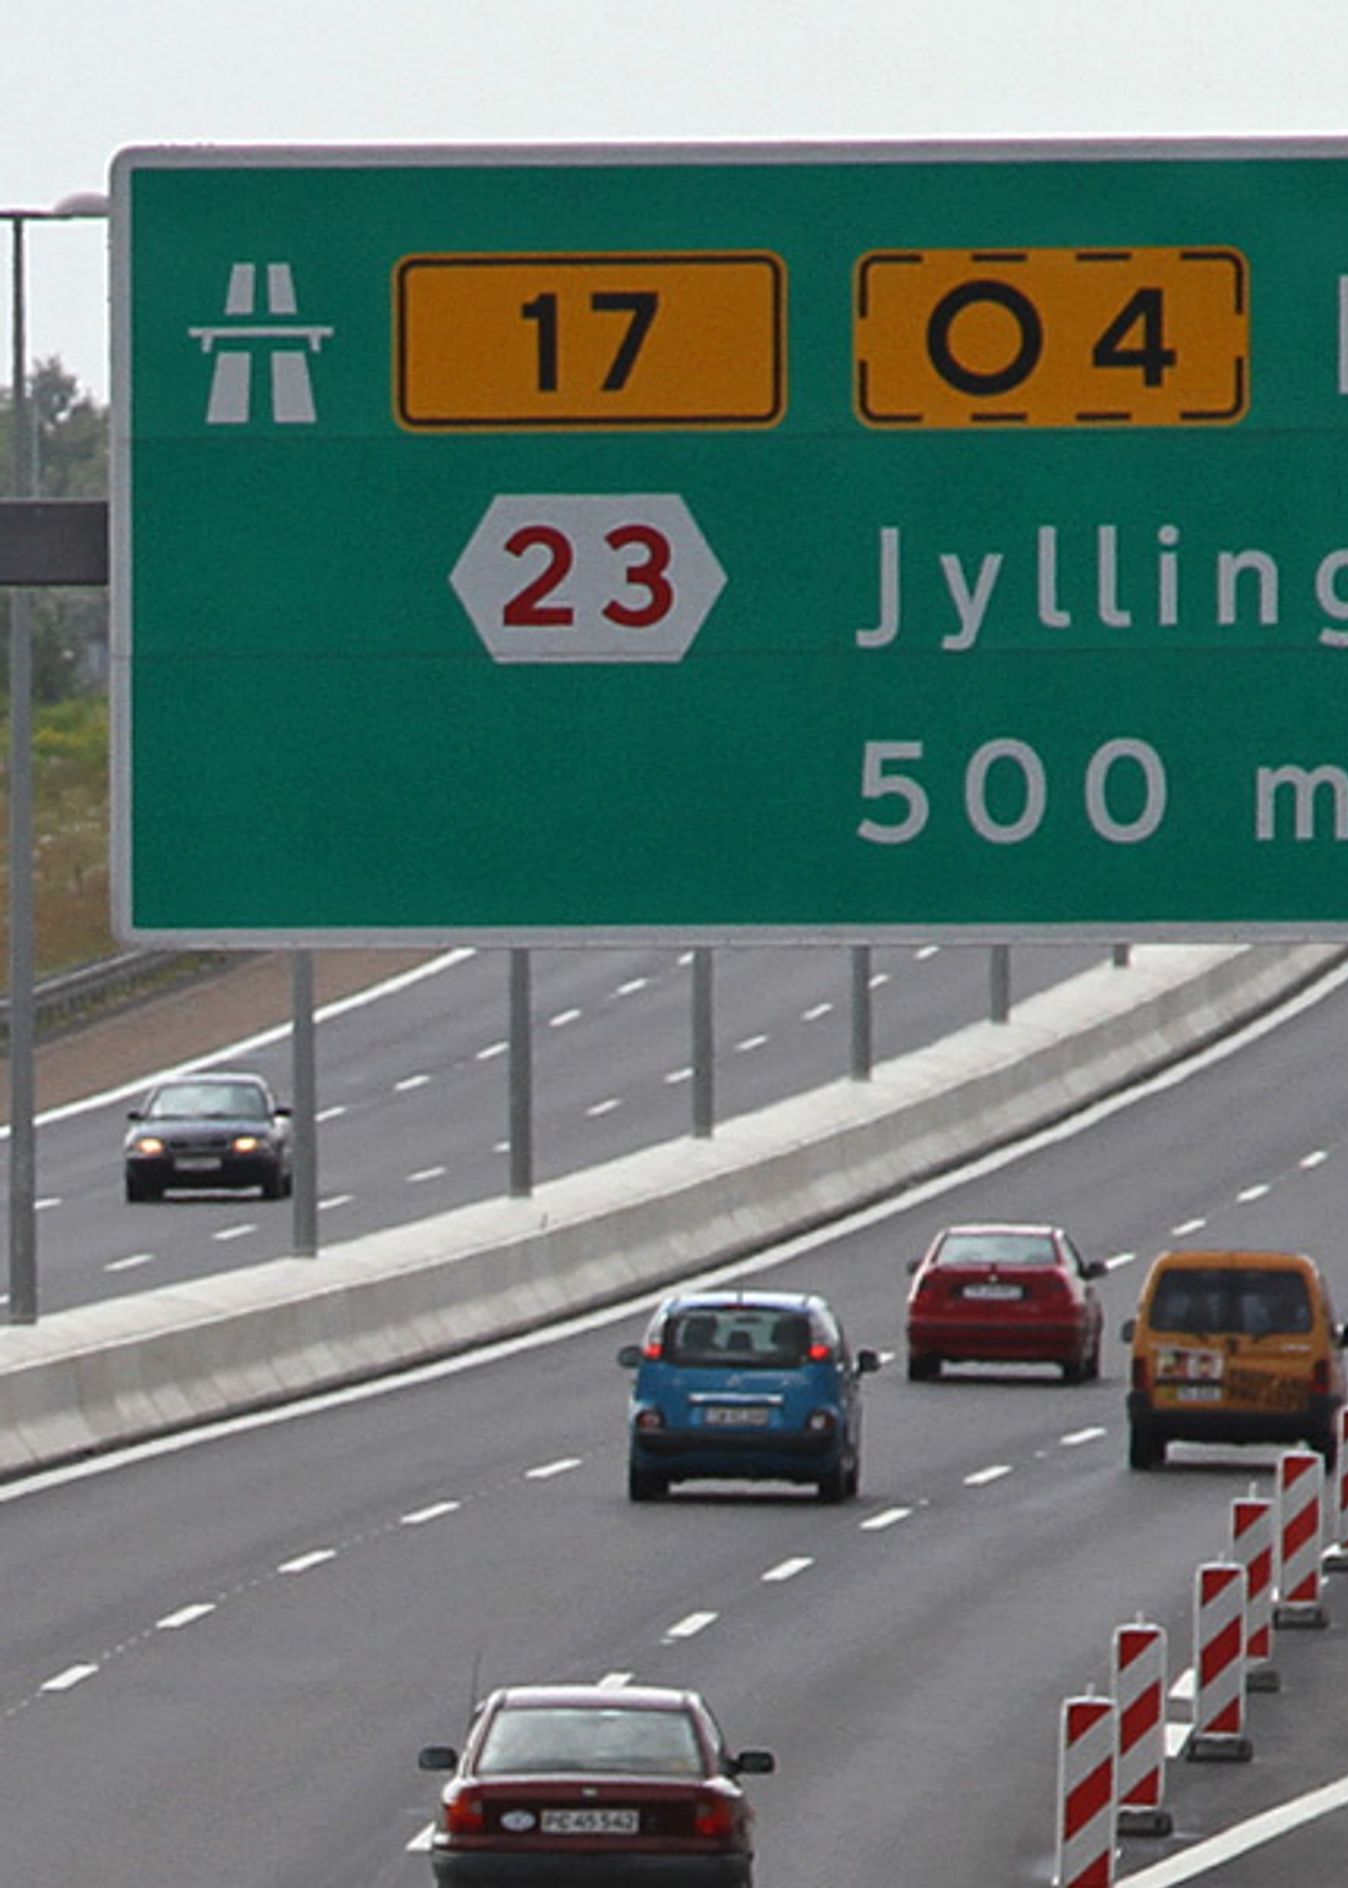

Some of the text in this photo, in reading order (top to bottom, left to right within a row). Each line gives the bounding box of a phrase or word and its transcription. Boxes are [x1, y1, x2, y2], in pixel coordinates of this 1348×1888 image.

[521, 292, 659, 393] 17
[503, 524, 674, 628] 23
[857, 738, 1168, 844] 500
